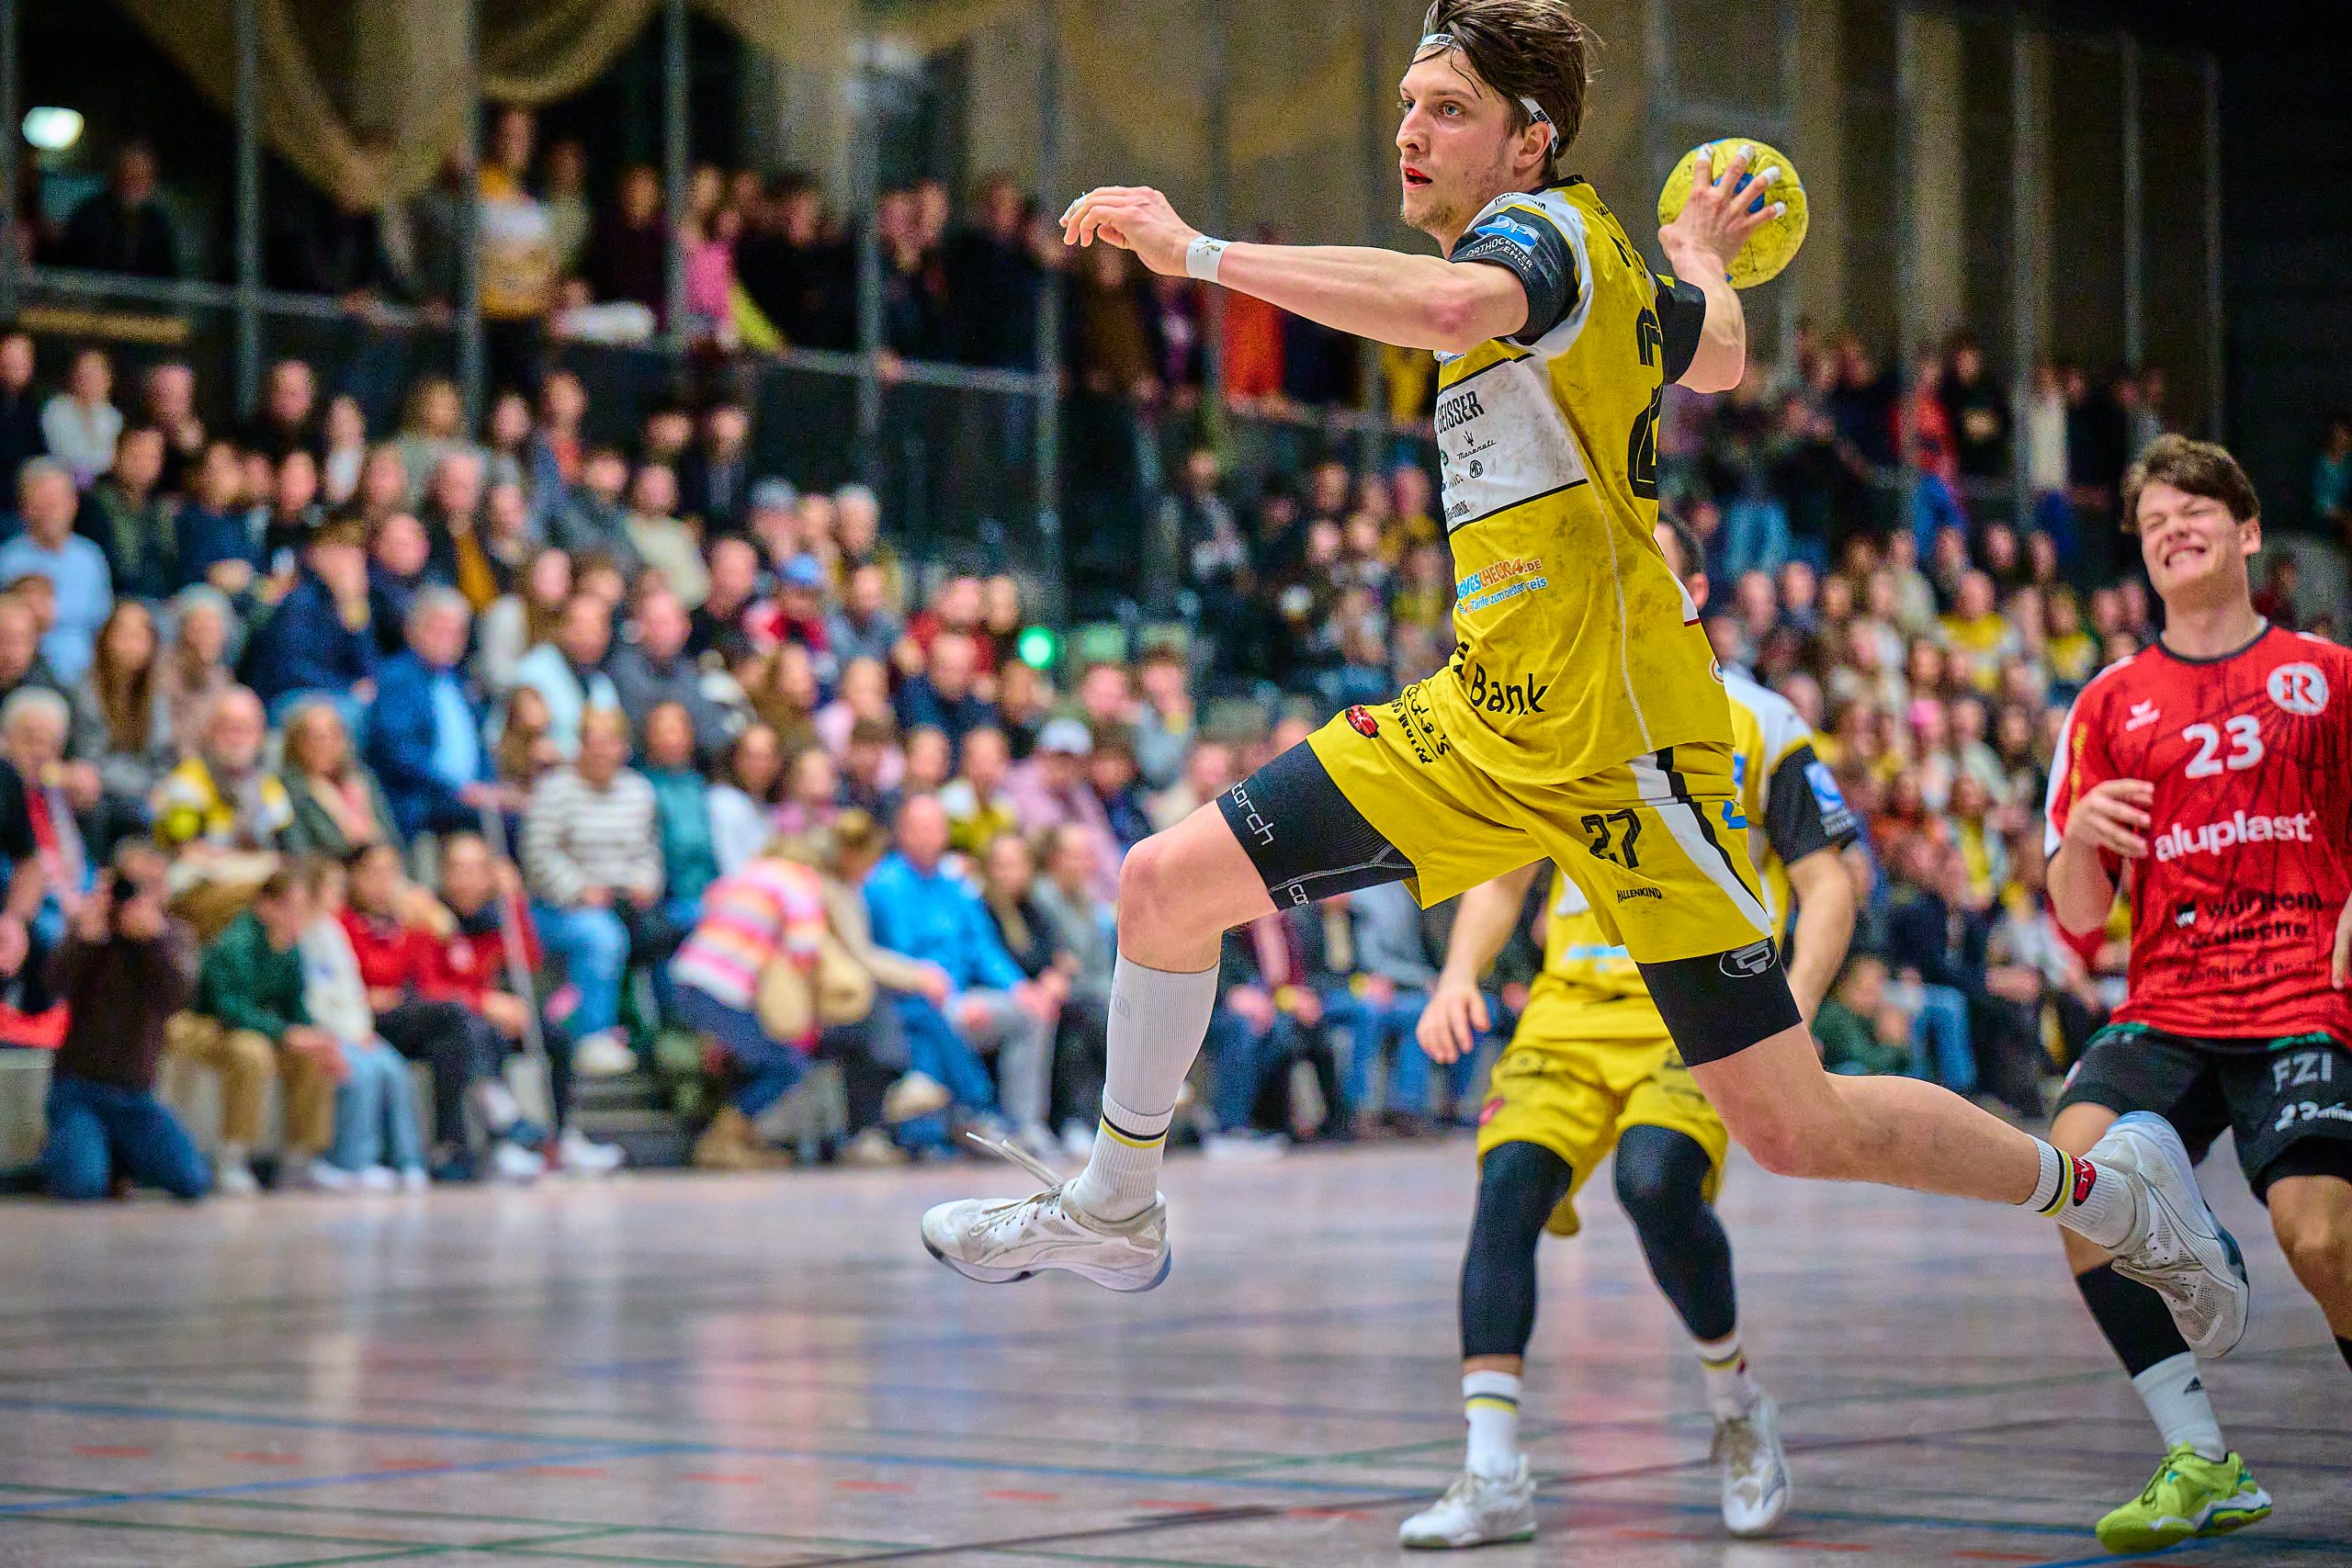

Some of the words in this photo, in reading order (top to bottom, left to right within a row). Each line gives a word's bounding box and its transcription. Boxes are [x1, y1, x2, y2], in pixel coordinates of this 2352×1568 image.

[1490, 591, 1506, 605] zum
[1470, 662, 1549, 716] Bank
[2182, 714, 2265, 780] 23
[1580, 808, 1642, 869] 27
[2154, 809, 2313, 862] aluplast
[1616, 886, 1662, 903] HALLENKIND
[2272, 1052, 2333, 1094] FZI
